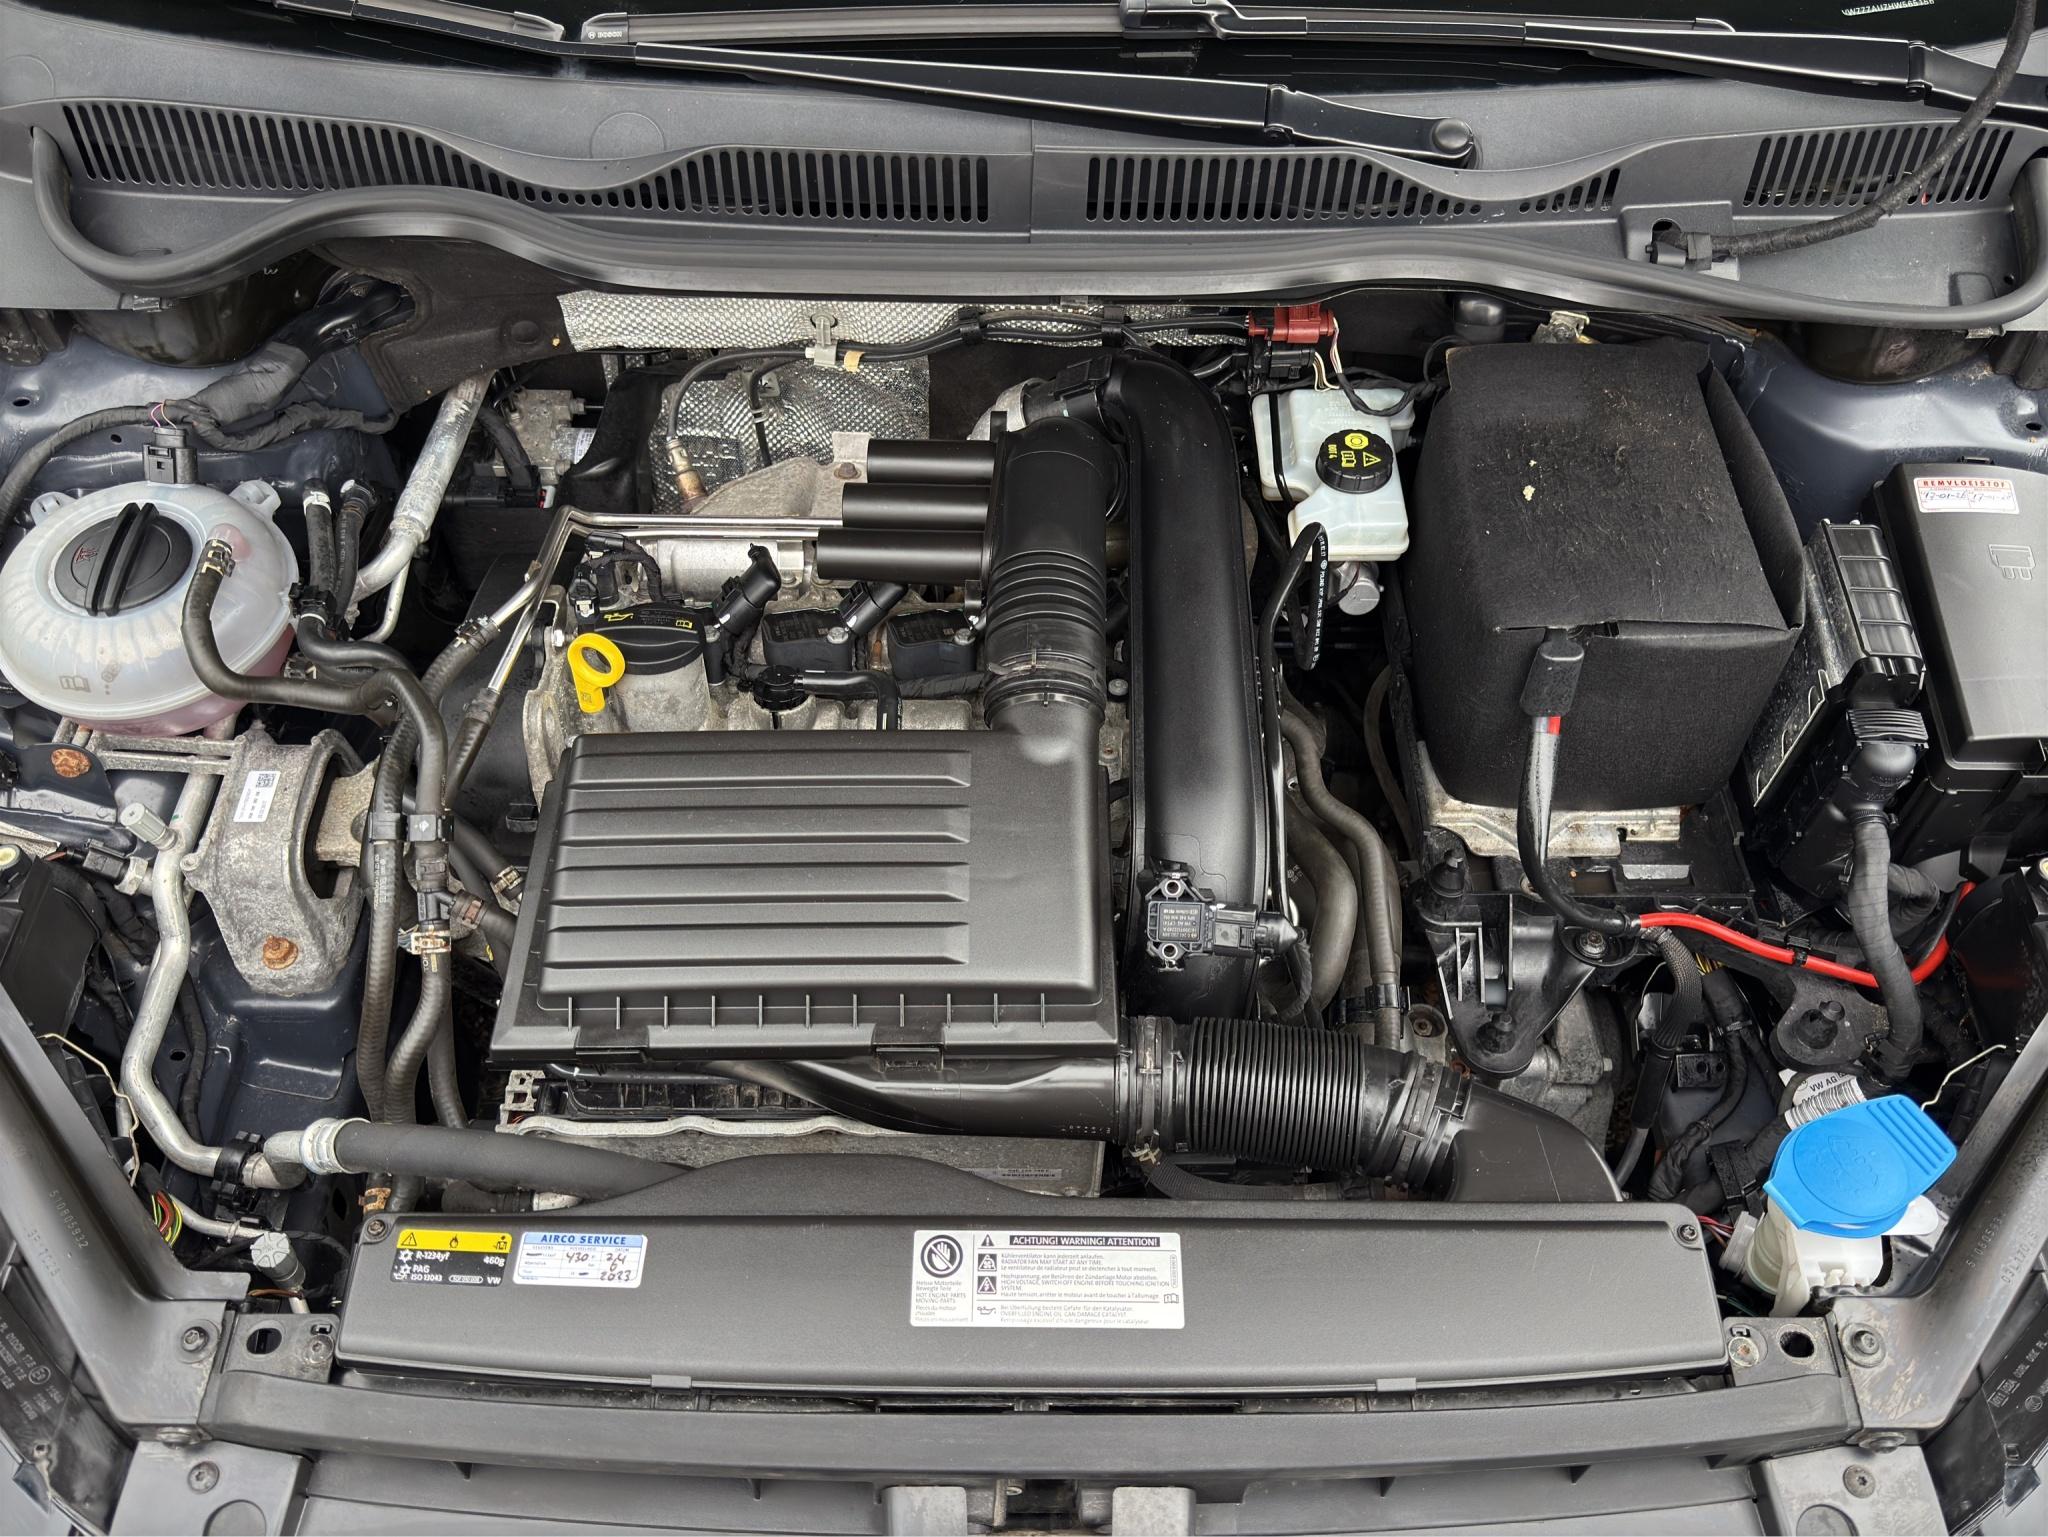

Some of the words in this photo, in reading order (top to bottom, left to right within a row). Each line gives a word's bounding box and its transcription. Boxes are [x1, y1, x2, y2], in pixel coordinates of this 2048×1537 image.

[1810, 1081, 1824, 1092] VW
[1826, 1075, 1838, 1086] AG
[541, 1234, 576, 1243] AIRCO
[579, 1235, 627, 1245] SERVICE
[1013, 1236, 1058, 1245] ACHTUNG!
[1060, 1237, 1105, 1246] WARNING!
[1107, 1238, 1157, 1247] ATTENTION!
[416, 1252, 450, 1262] R-1234yf
[483, 1256, 505, 1267] 460g
[566, 1252, 589, 1263] 430
[413, 1265, 430, 1273] PAG
[600, 1269, 632, 1281] 2023
